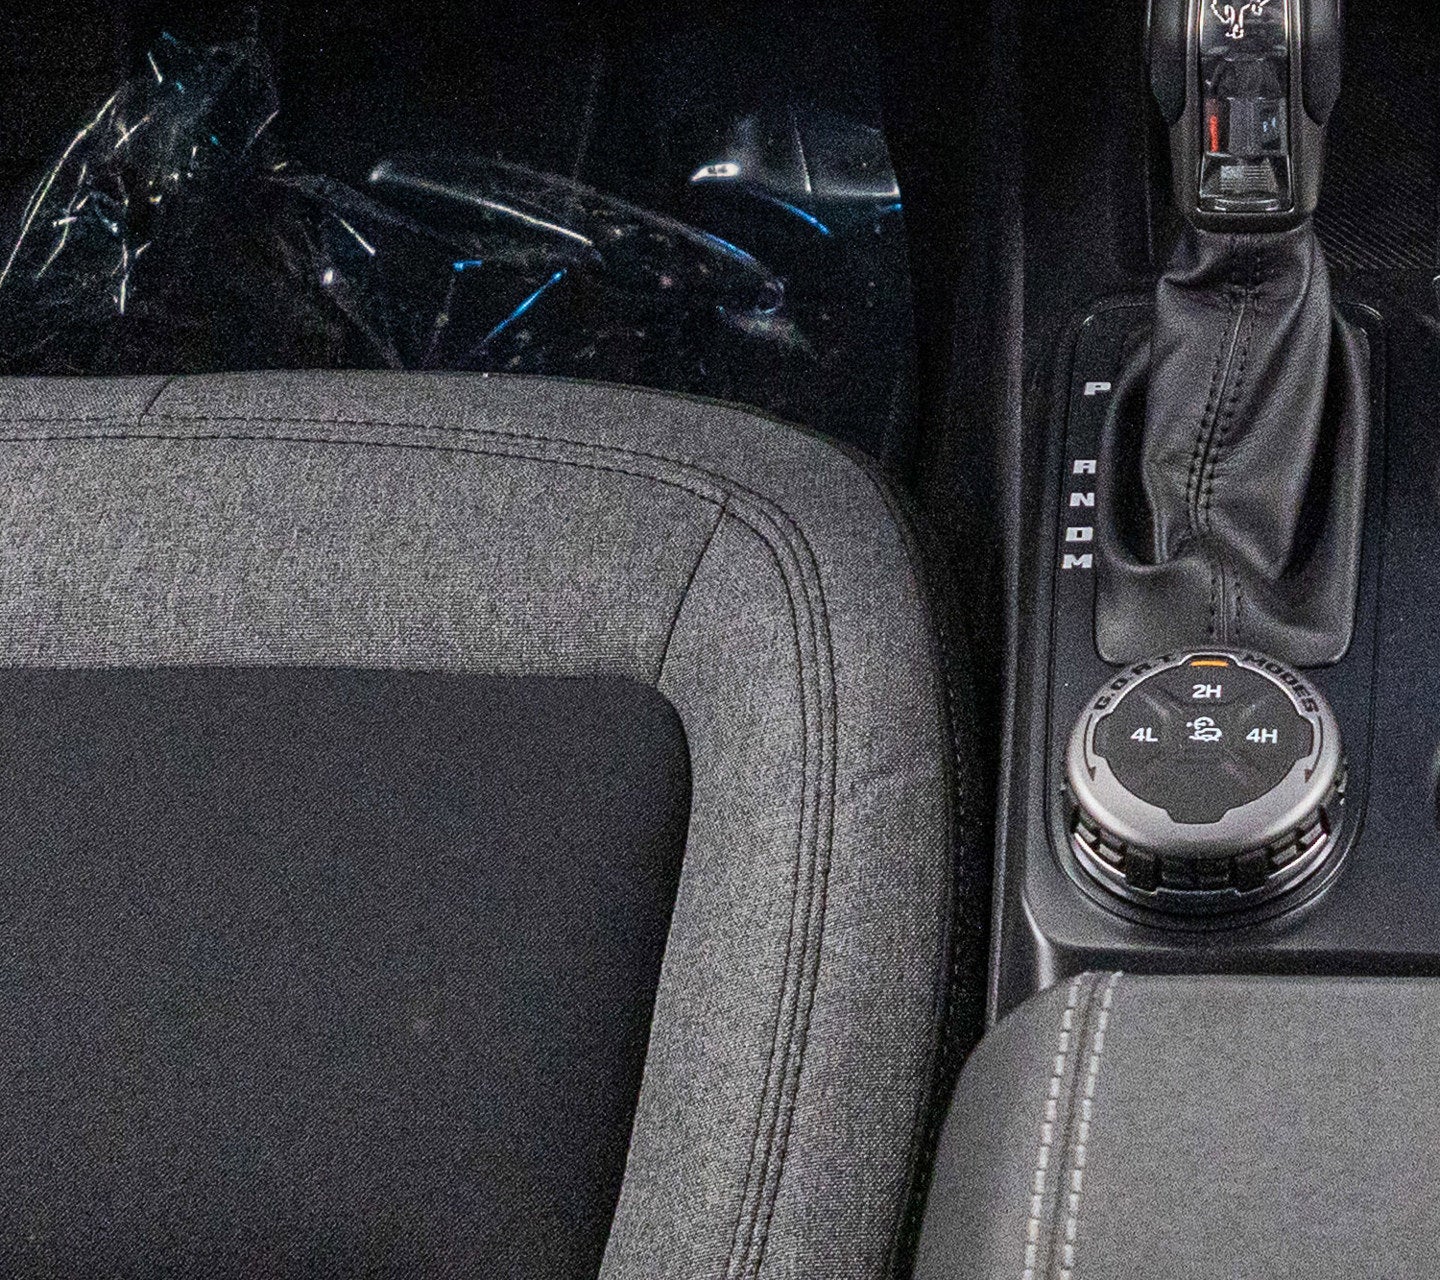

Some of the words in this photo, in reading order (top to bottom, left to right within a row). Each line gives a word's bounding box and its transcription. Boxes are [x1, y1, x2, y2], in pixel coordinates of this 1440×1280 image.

[1084, 381, 1111, 395] P
[1070, 492, 1095, 506] N
[1065, 526, 1093, 542] D
[1062, 553, 1093, 569] M
[1192, 683, 1222, 699] 2H
[1244, 653, 1319, 713] MODES
[1130, 727, 1159, 743] 4L
[1245, 727, 1278, 744] 4H
